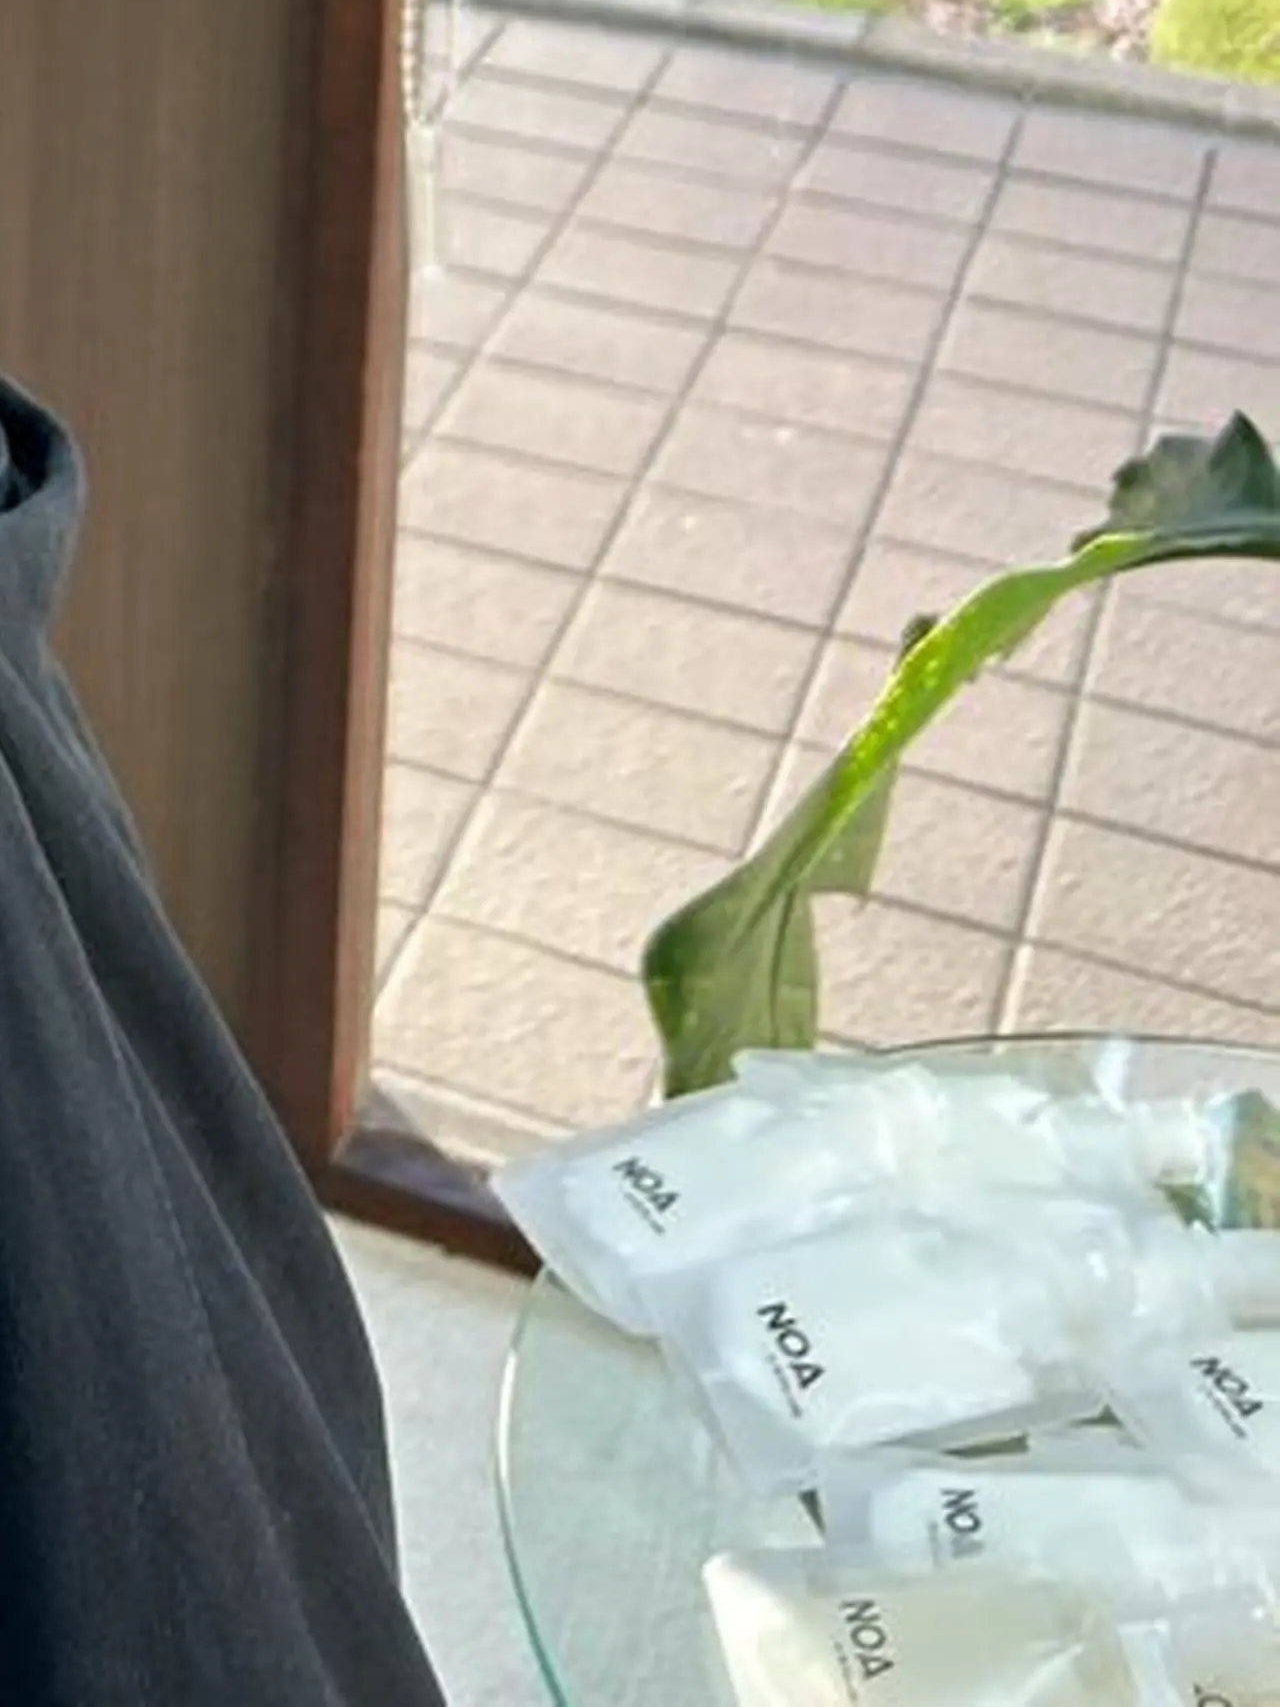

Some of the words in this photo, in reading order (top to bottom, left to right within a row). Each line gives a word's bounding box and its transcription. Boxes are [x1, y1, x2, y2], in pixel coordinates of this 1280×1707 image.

[611, 1155, 681, 1213] NOA
[756, 1300, 825, 1390] NOA
[1189, 1356, 1263, 1418] NOA
[840, 1600, 894, 1681] NOA
